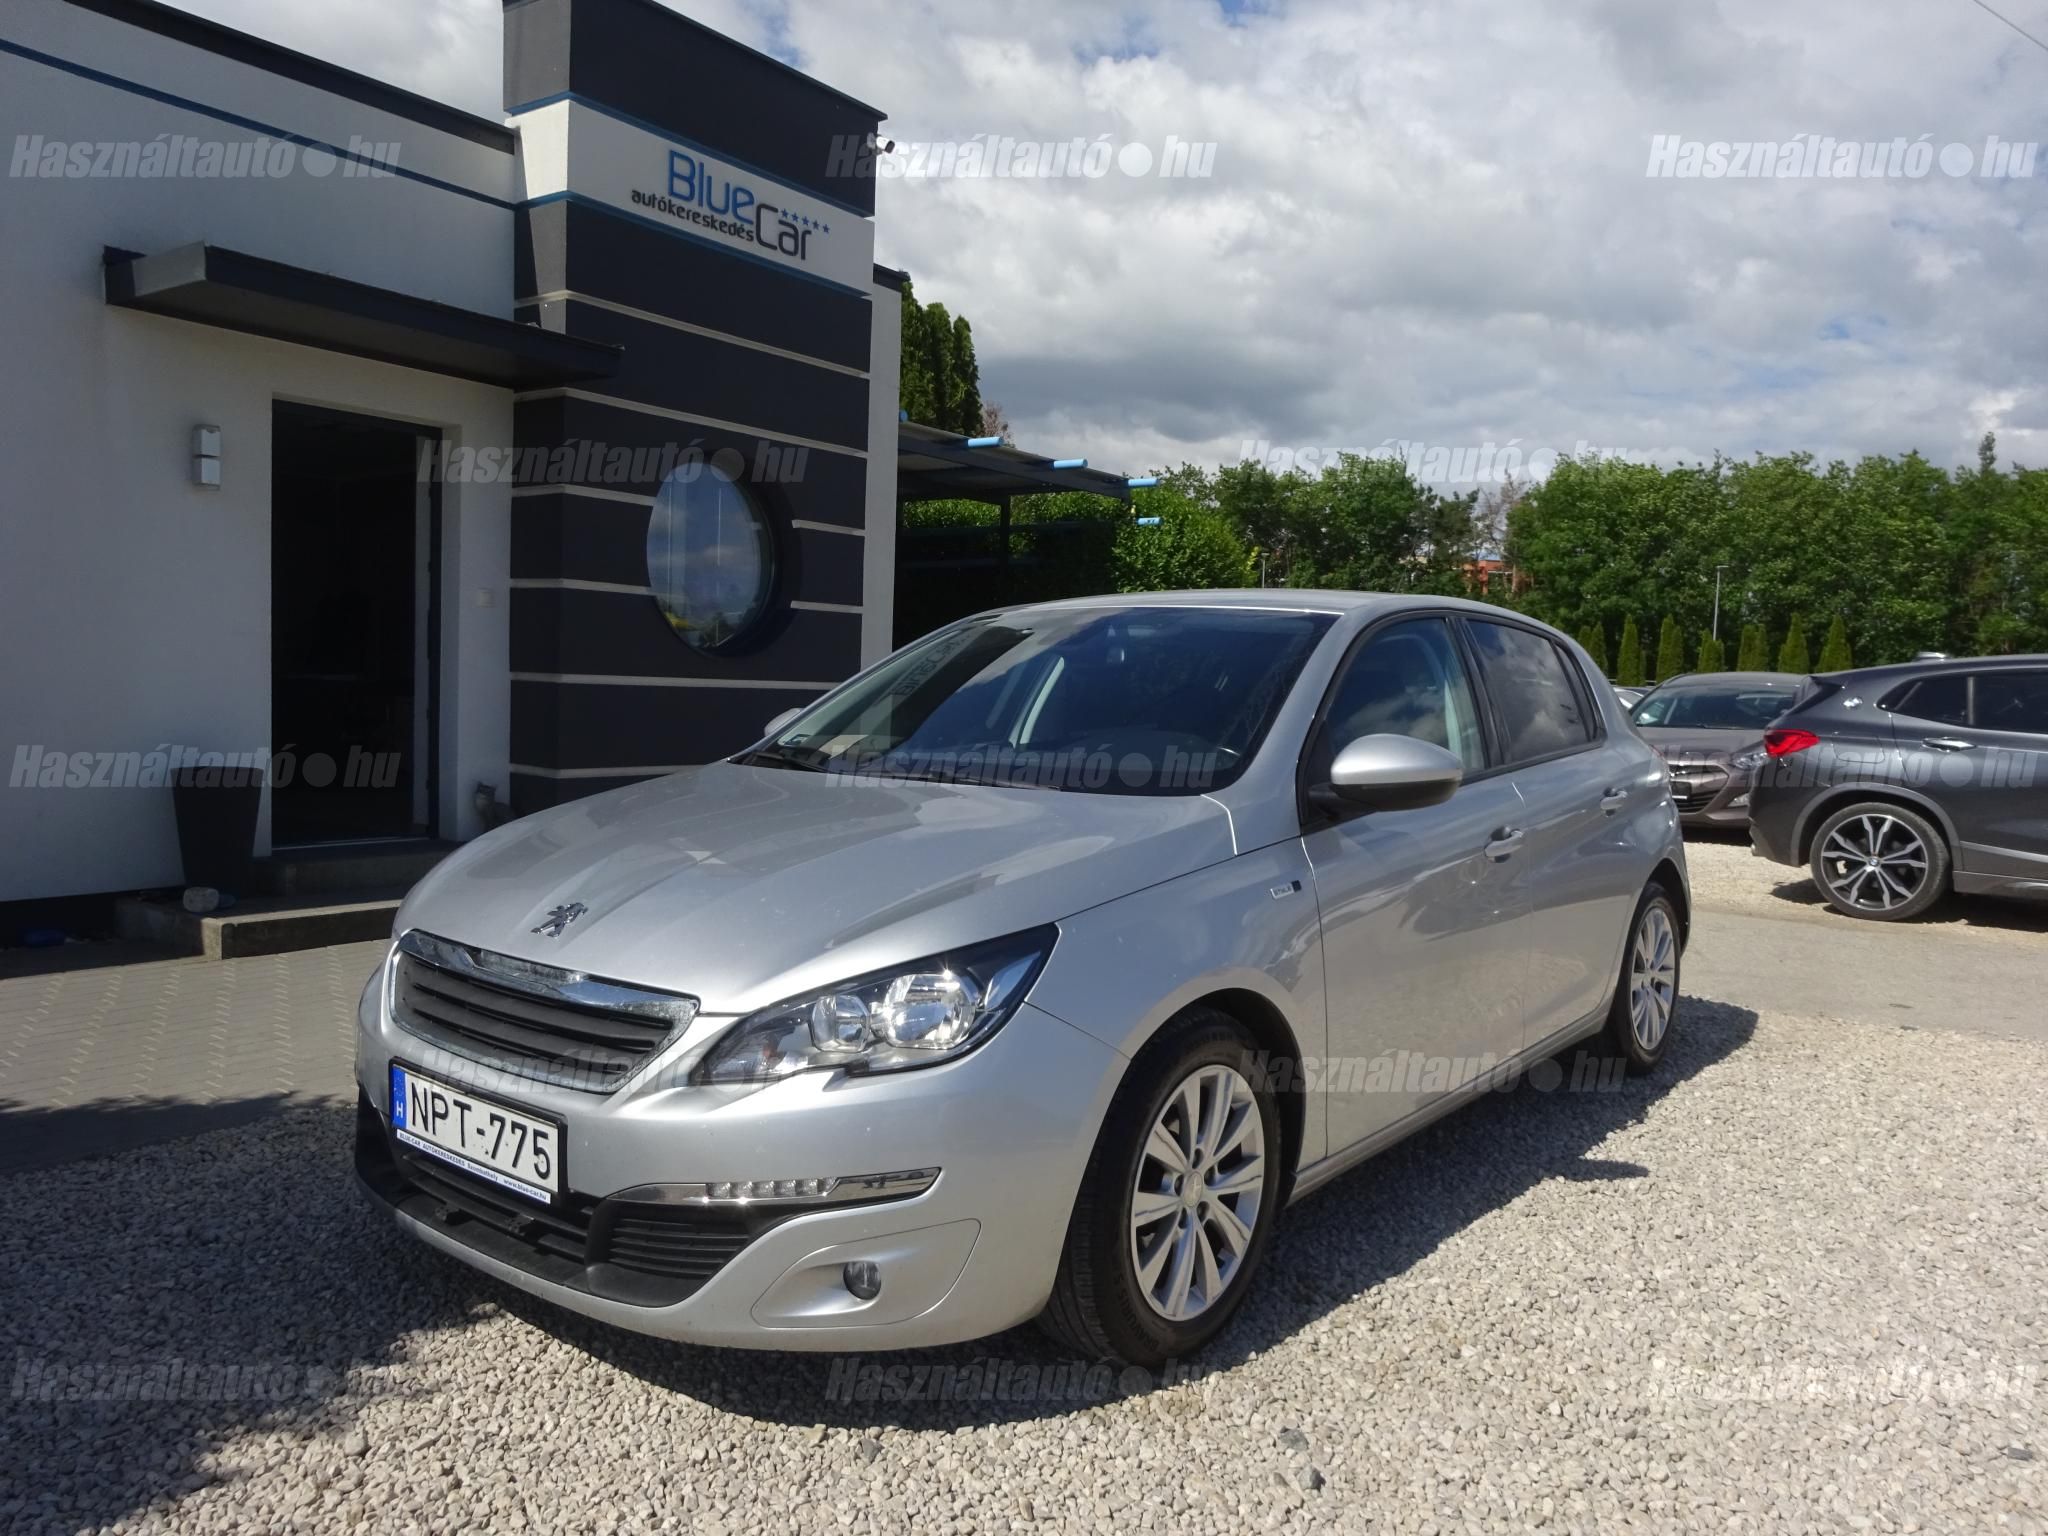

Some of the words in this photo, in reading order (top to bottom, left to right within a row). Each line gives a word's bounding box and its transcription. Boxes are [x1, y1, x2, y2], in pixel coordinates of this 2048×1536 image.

[630, 187, 755, 243] autókereskedés
[395, 1100, 404, 1119] H
[411, 1081, 551, 1181] NPT-775
